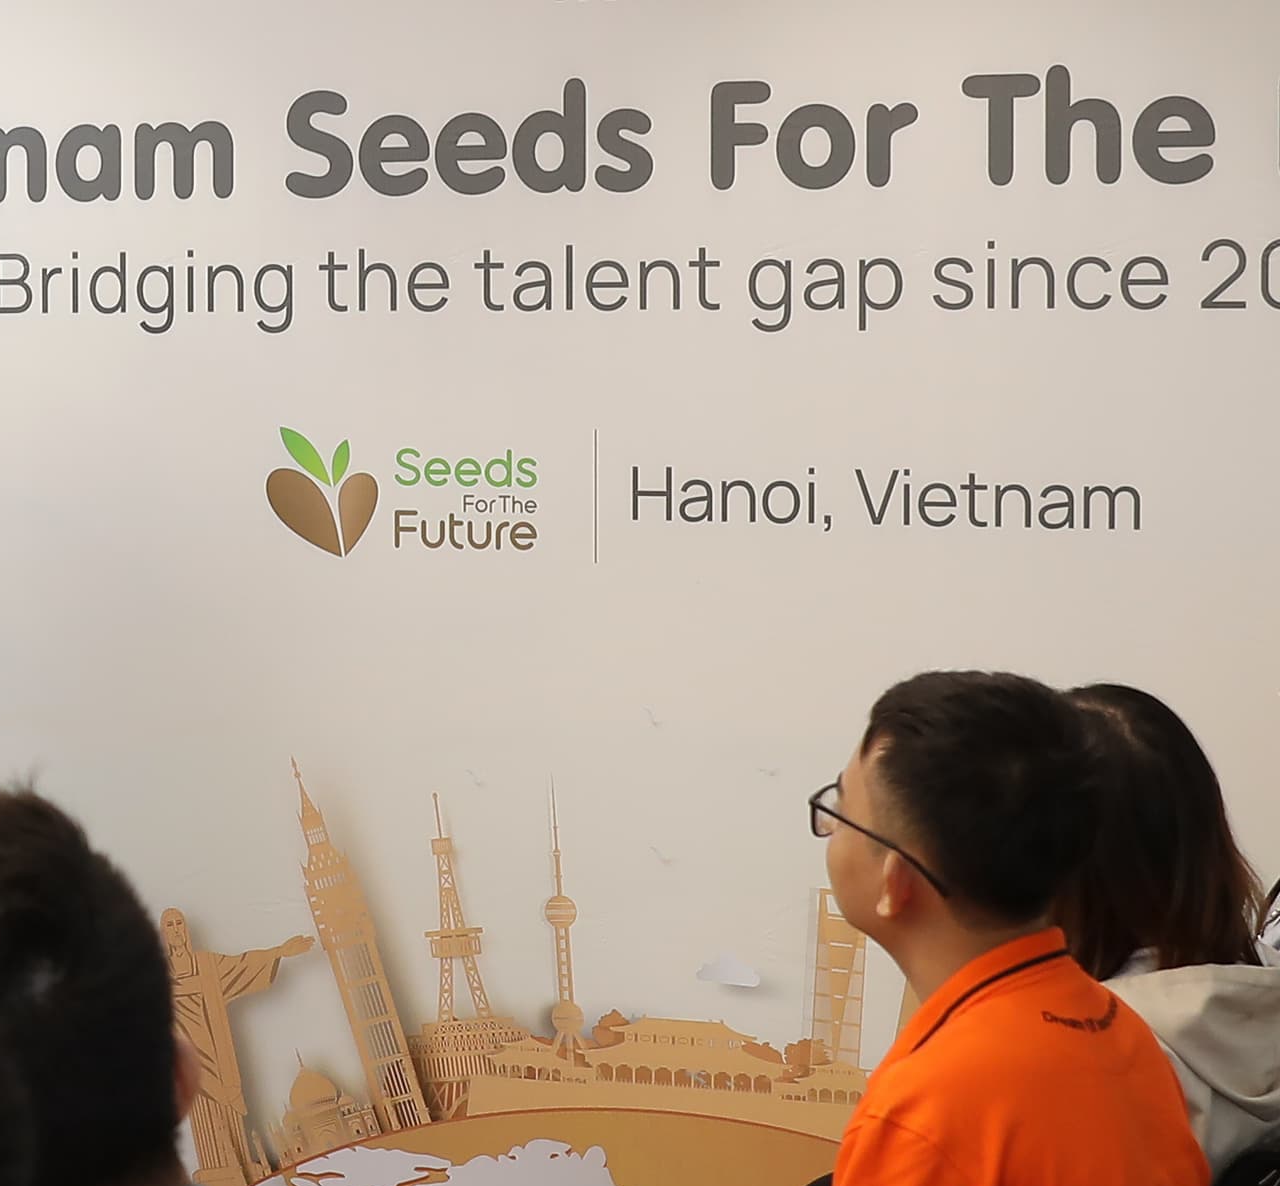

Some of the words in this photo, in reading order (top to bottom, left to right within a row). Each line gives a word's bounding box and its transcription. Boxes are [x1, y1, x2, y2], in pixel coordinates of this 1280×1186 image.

[286, 78, 653, 199] Seeds
[711, 81, 918, 191] For
[962, 65, 1215, 187] The
[318, 249, 450, 313] the
[473, 245, 721, 312] talent
[748, 257, 903, 333] gap
[932, 240, 1169, 311] since
[394, 447, 538, 488] Seeds
[632, 466, 832, 532] Hanoi,
[854, 468, 1141, 531] Vietnam
[394, 509, 538, 551] Future
